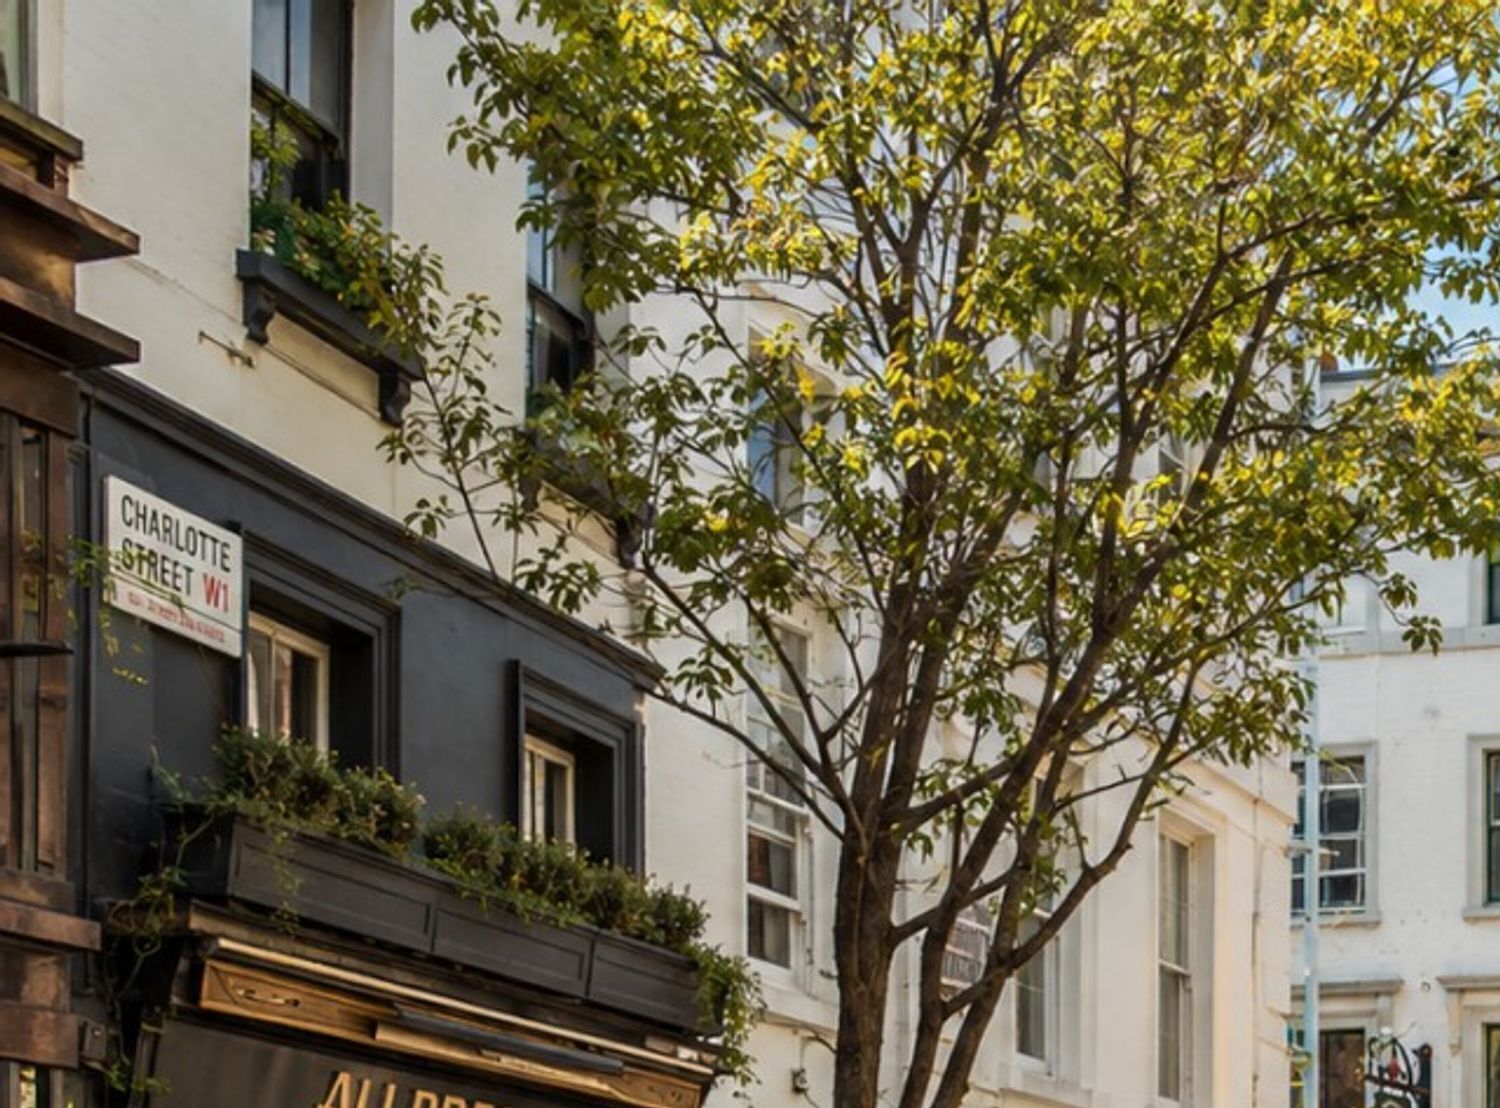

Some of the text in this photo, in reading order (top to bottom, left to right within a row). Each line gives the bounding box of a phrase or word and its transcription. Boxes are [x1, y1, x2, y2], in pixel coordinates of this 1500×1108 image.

[121, 494, 232, 573] CHARLOTTE
[121, 537, 229, 613] STREET W1
